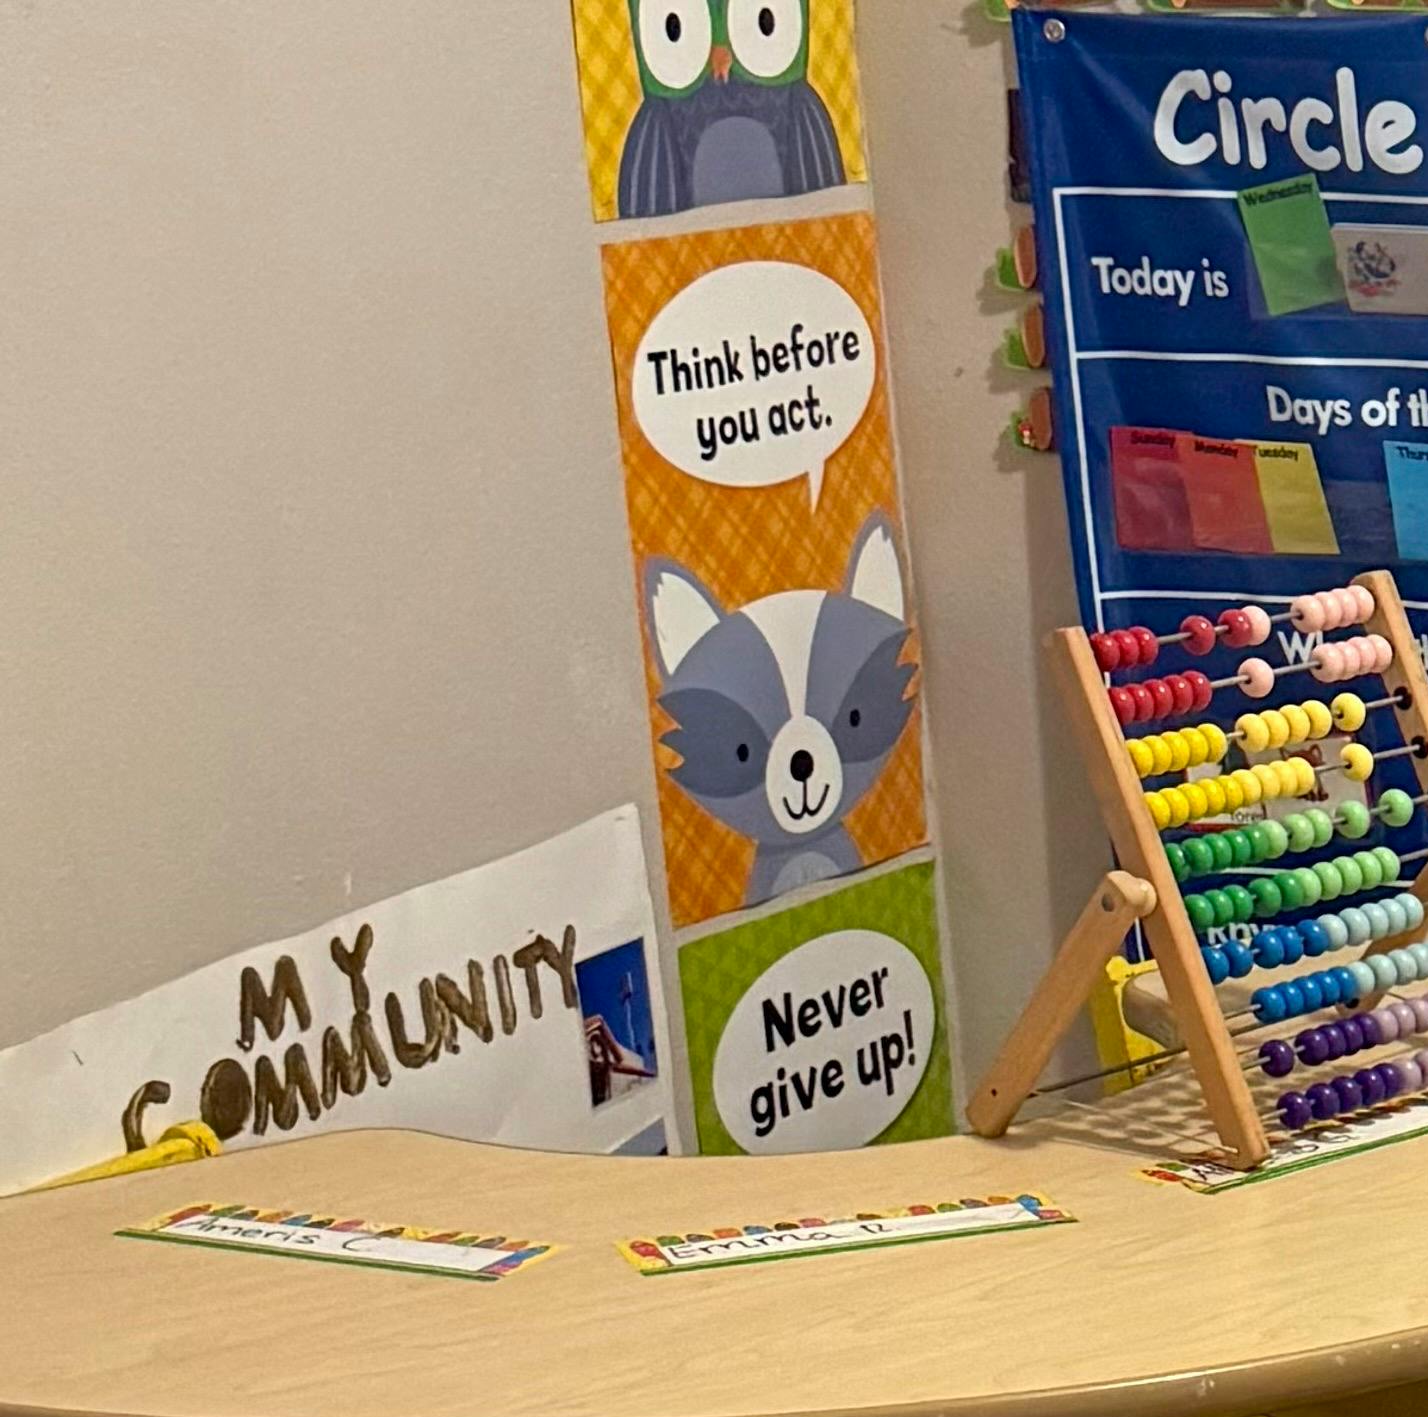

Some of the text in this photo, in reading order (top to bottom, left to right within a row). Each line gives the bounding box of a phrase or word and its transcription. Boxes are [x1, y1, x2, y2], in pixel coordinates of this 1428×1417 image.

[1153, 66, 1424, 173] Circle
[1092, 256, 1229, 306] Today is
[646, 322, 862, 396] Think before
[695, 384, 834, 462] you act.
[1130, 429, 1177, 449] Sunday
[1267, 386, 1351, 435] Days
[1360, 386, 1402, 427] of
[235, 922, 375, 1053] MY
[761, 965, 890, 1054] Never
[121, 924, 578, 1153] COMMUNITY
[748, 1009, 918, 1139] give up!
[669, 1225, 846, 1260] Emma
